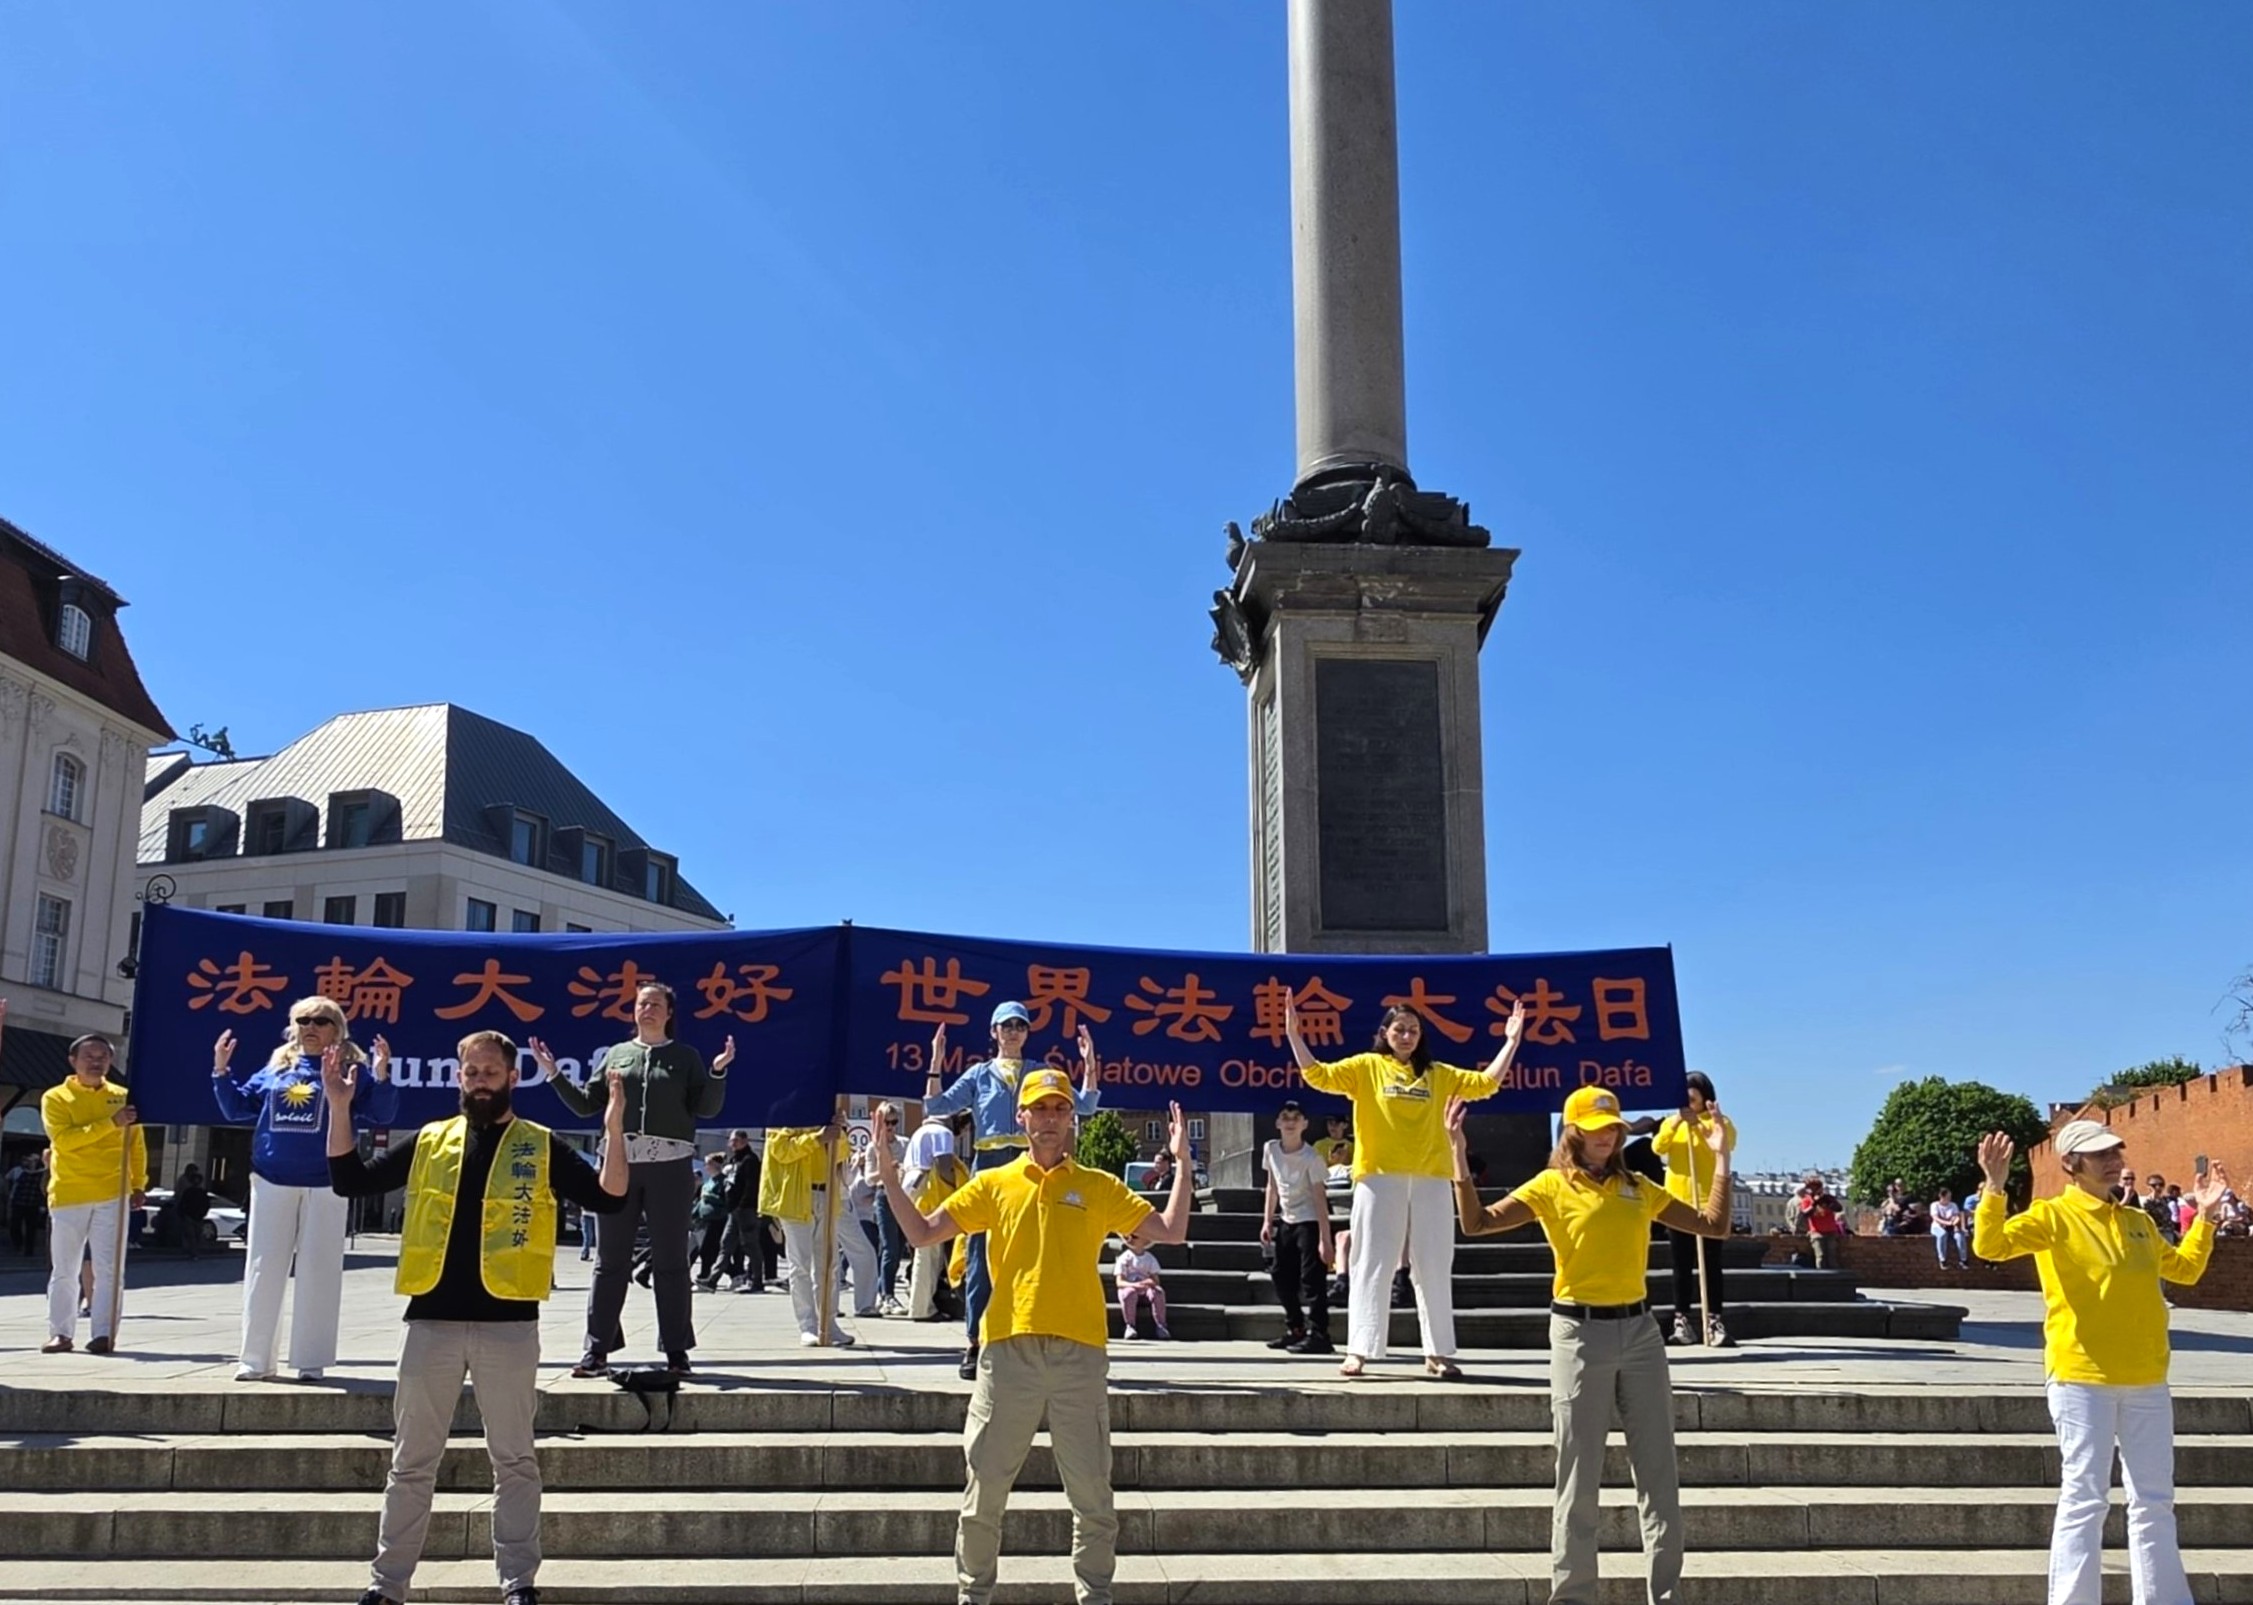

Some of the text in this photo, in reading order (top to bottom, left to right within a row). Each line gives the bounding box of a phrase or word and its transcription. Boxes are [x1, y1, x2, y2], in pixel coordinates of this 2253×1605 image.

[186, 951, 794, 1024] 法輪大法好
[880, 956, 1653, 1047] 世界法輪大法日
[886, 1042, 923, 1072] 13
[1579, 1060, 1652, 1088] Dafa
[850, 1134, 868, 1146] 30
[510, 1142, 537, 1248] 法輪大法好
